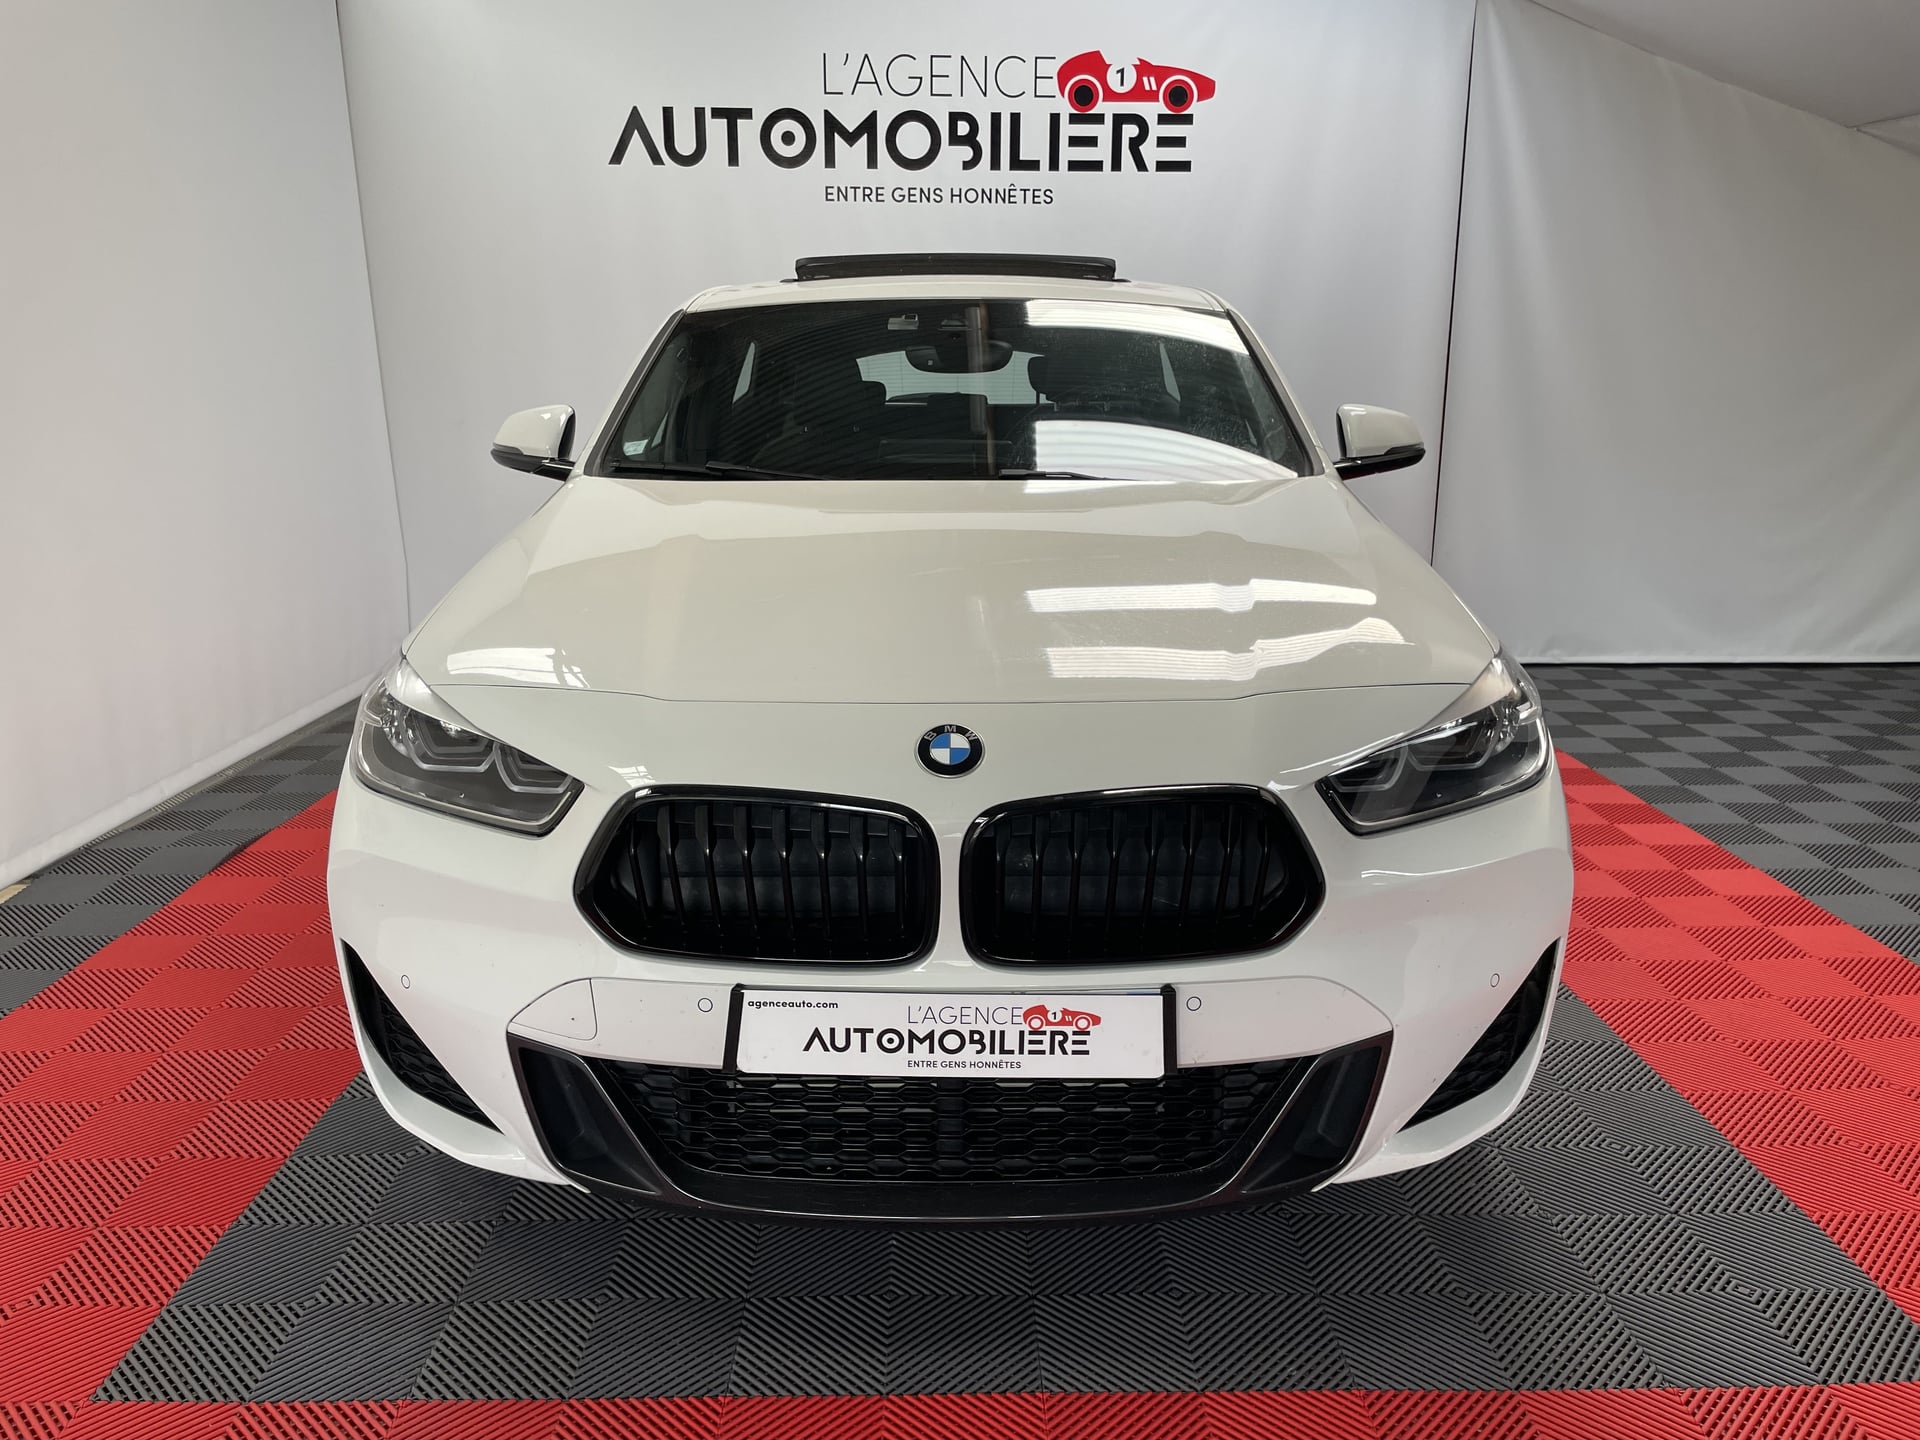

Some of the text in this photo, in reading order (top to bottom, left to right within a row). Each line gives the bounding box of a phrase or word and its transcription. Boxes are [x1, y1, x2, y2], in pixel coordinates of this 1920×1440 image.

[822, 52, 1057, 99] L'AGENCE
[1115, 66, 1126, 88] 1
[608, 105, 1194, 173] AUTOMOBILIERE
[824, 183, 1054, 205] ENTRE GENS HONNÊTES
[923, 725, 978, 741] BMW
[747, 1000, 839, 1009] agenceauto.com
[907, 1005, 1023, 1026] L'AGENCE
[1051, 1011, 1057, 1021] 1
[802, 1026, 1092, 1056] AUTOMOBILIERE
[907, 1059, 1022, 1069] ENTRE GENS HONNÊTES
